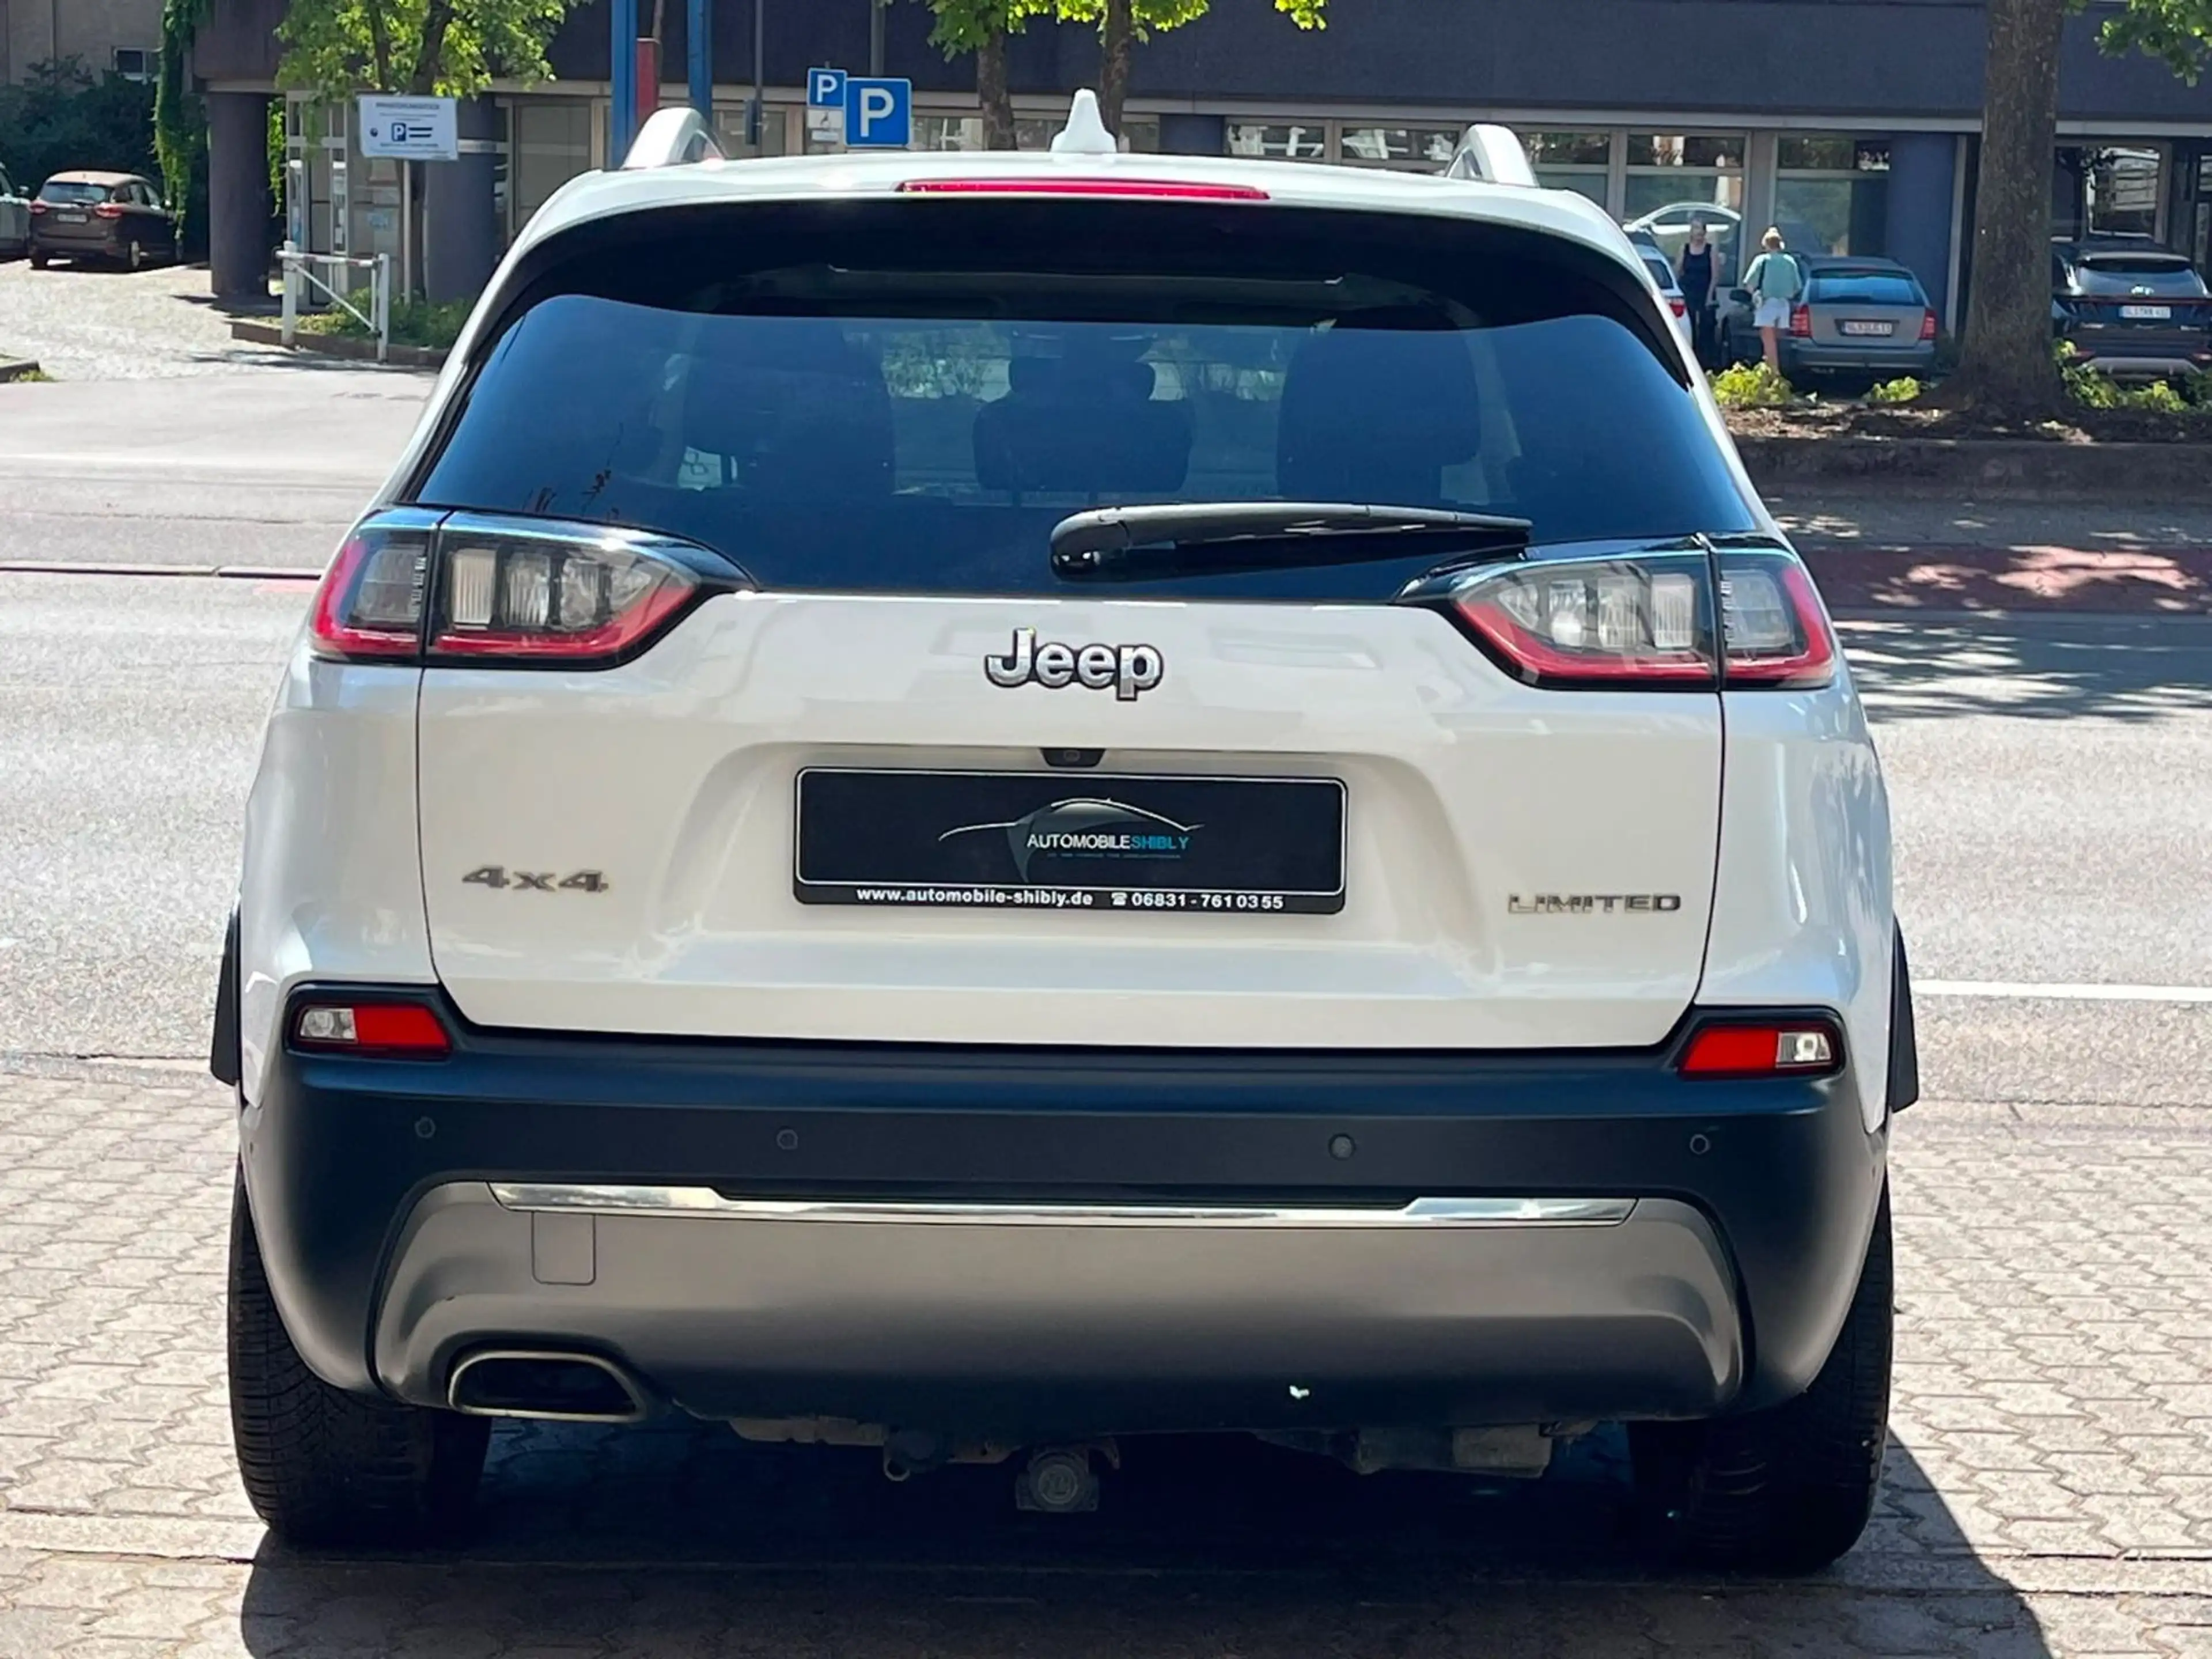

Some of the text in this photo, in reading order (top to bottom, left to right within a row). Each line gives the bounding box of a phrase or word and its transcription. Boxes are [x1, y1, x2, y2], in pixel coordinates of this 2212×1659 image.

[817, 74, 838, 103] P
[860, 88, 894, 137] P
[393, 124, 404, 141] P
[984, 627, 1164, 701] Jeep
[856, 888, 1093, 907] www.automobile-shibly.de
[1508, 894, 1681, 914] LIMITED
